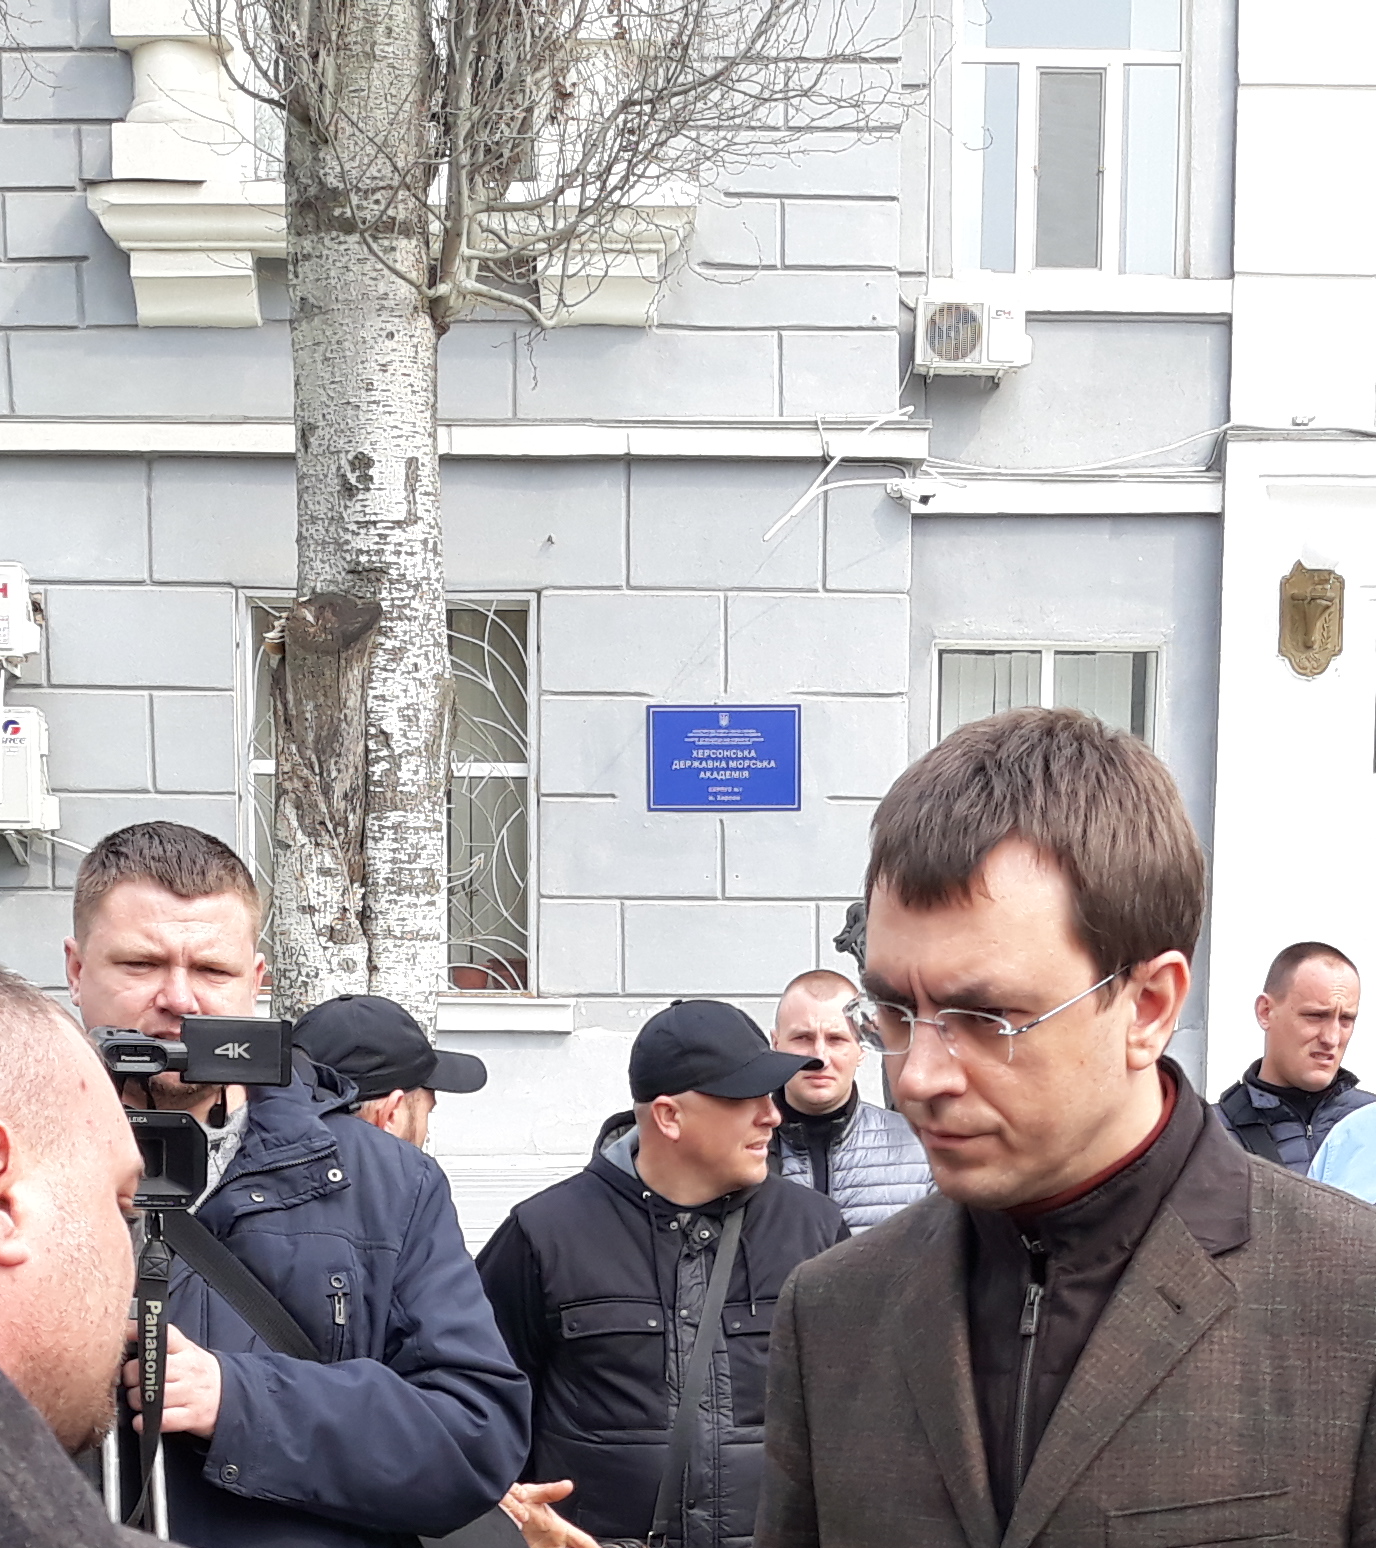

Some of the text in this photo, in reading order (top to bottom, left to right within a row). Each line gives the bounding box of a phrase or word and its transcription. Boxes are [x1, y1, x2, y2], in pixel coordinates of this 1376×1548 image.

[691, 749, 757, 758] ХЕРСОНСЬКА
[671, 760, 776, 770] ДЕРЖАВНА МОРСЬКА
[698, 771, 750, 780] АКАДЕМІЯ
[214, 1042, 252, 1060] 4K
[144, 1299, 164, 1404] Panasonic
